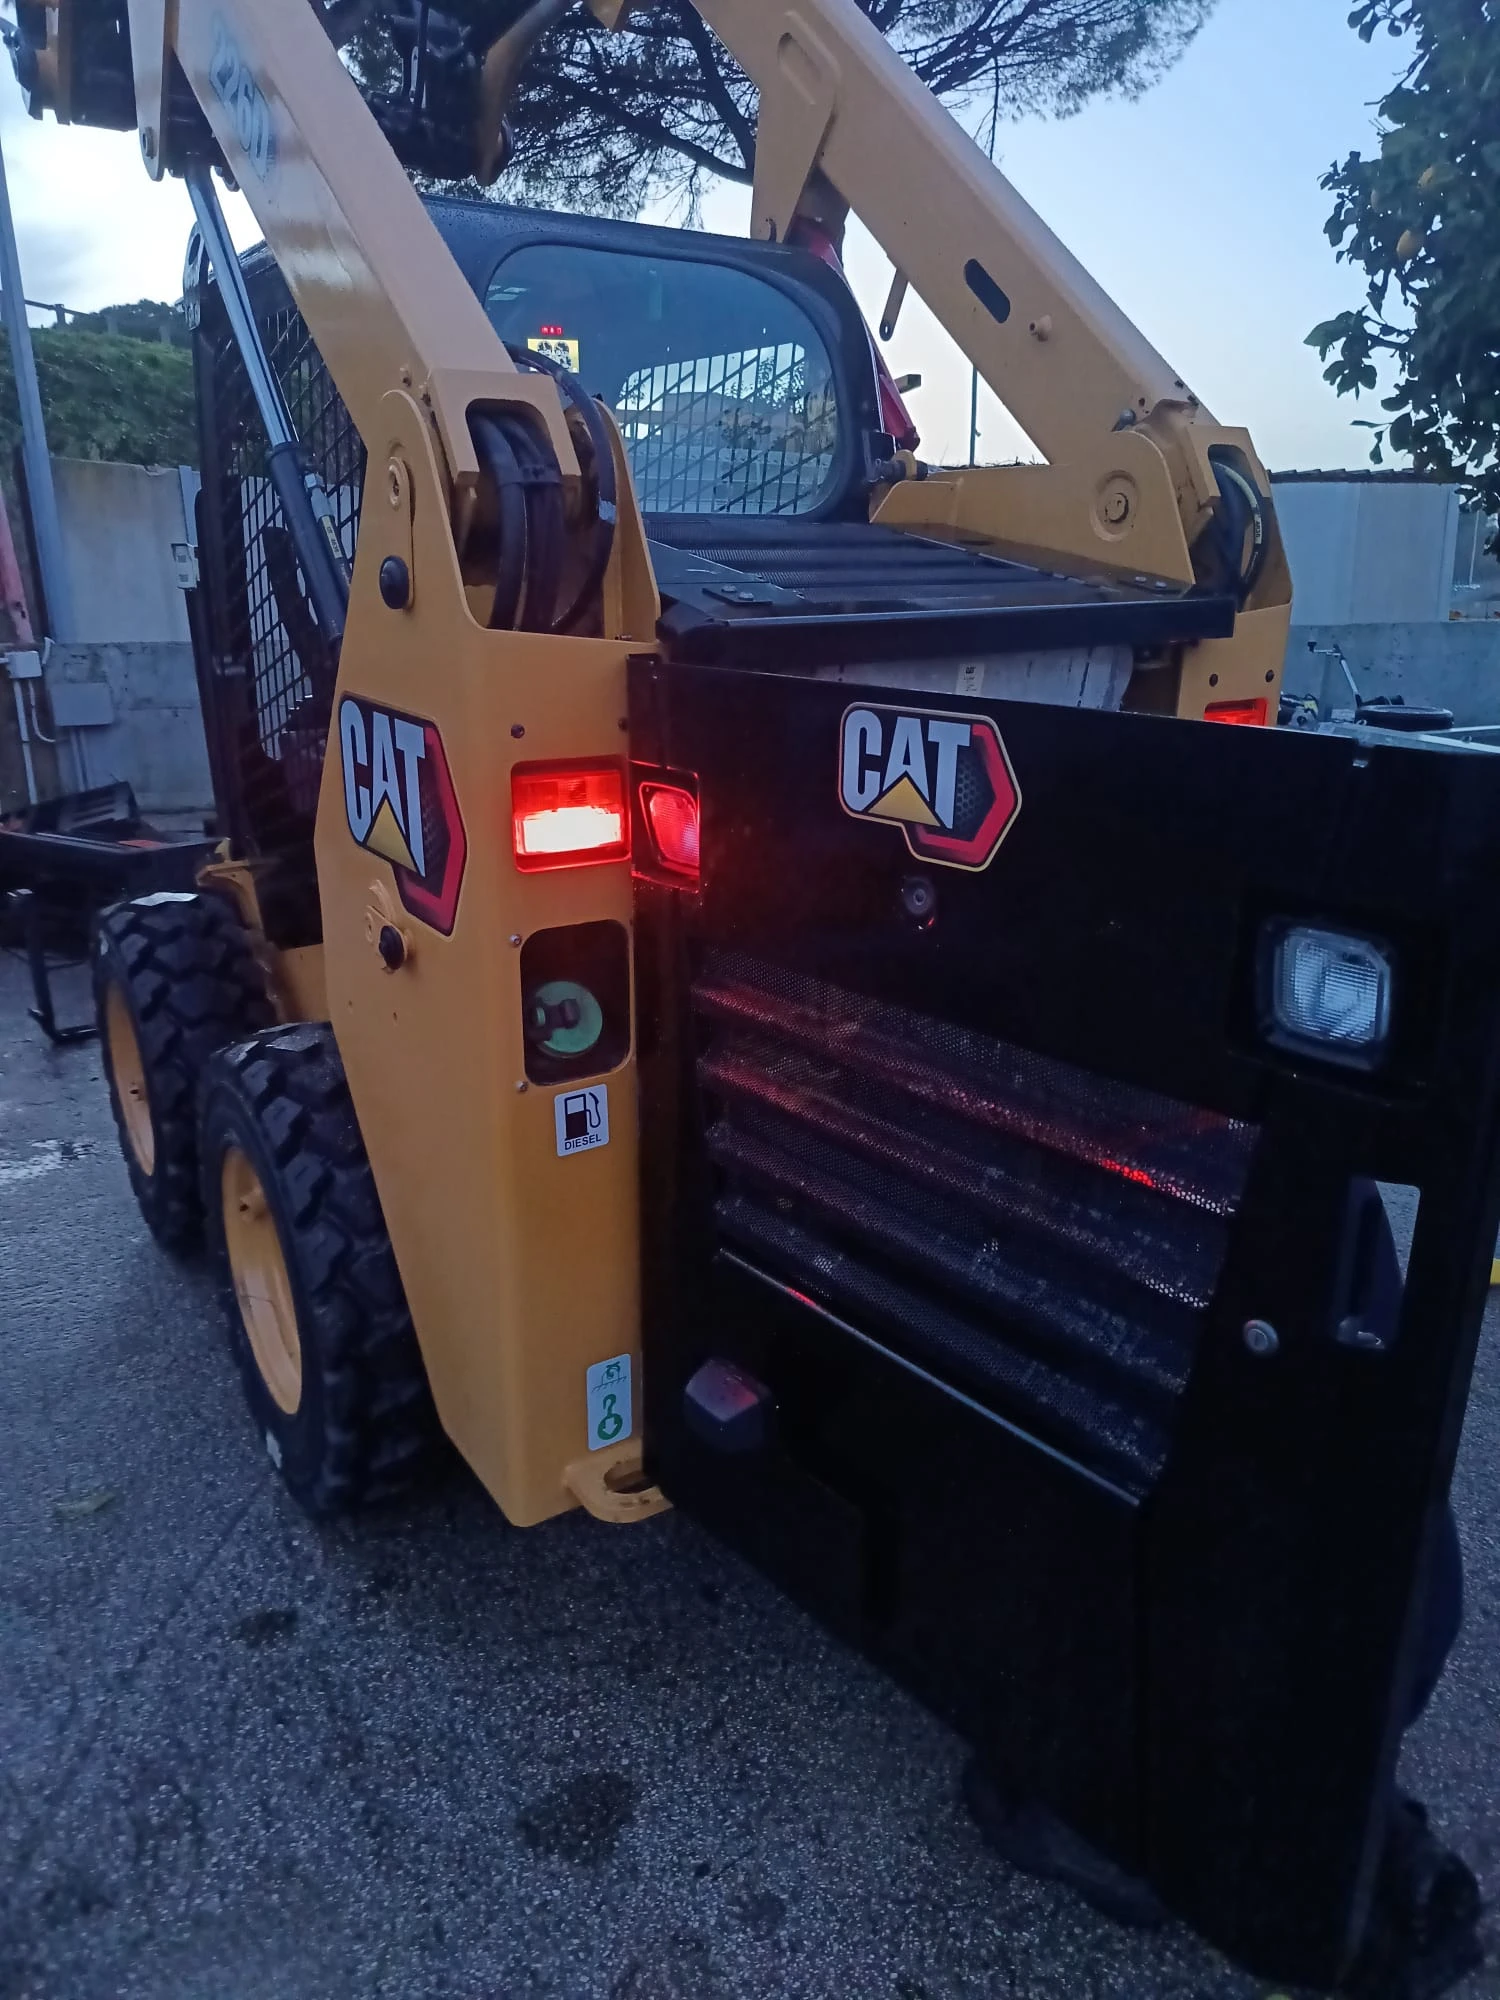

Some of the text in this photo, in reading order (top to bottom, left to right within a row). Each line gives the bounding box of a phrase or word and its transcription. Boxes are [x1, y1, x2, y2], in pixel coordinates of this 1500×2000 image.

[340, 700, 425, 878] CAT
[843, 709, 971, 829] CAT
[564, 1133, 602, 1150] DIESEL
